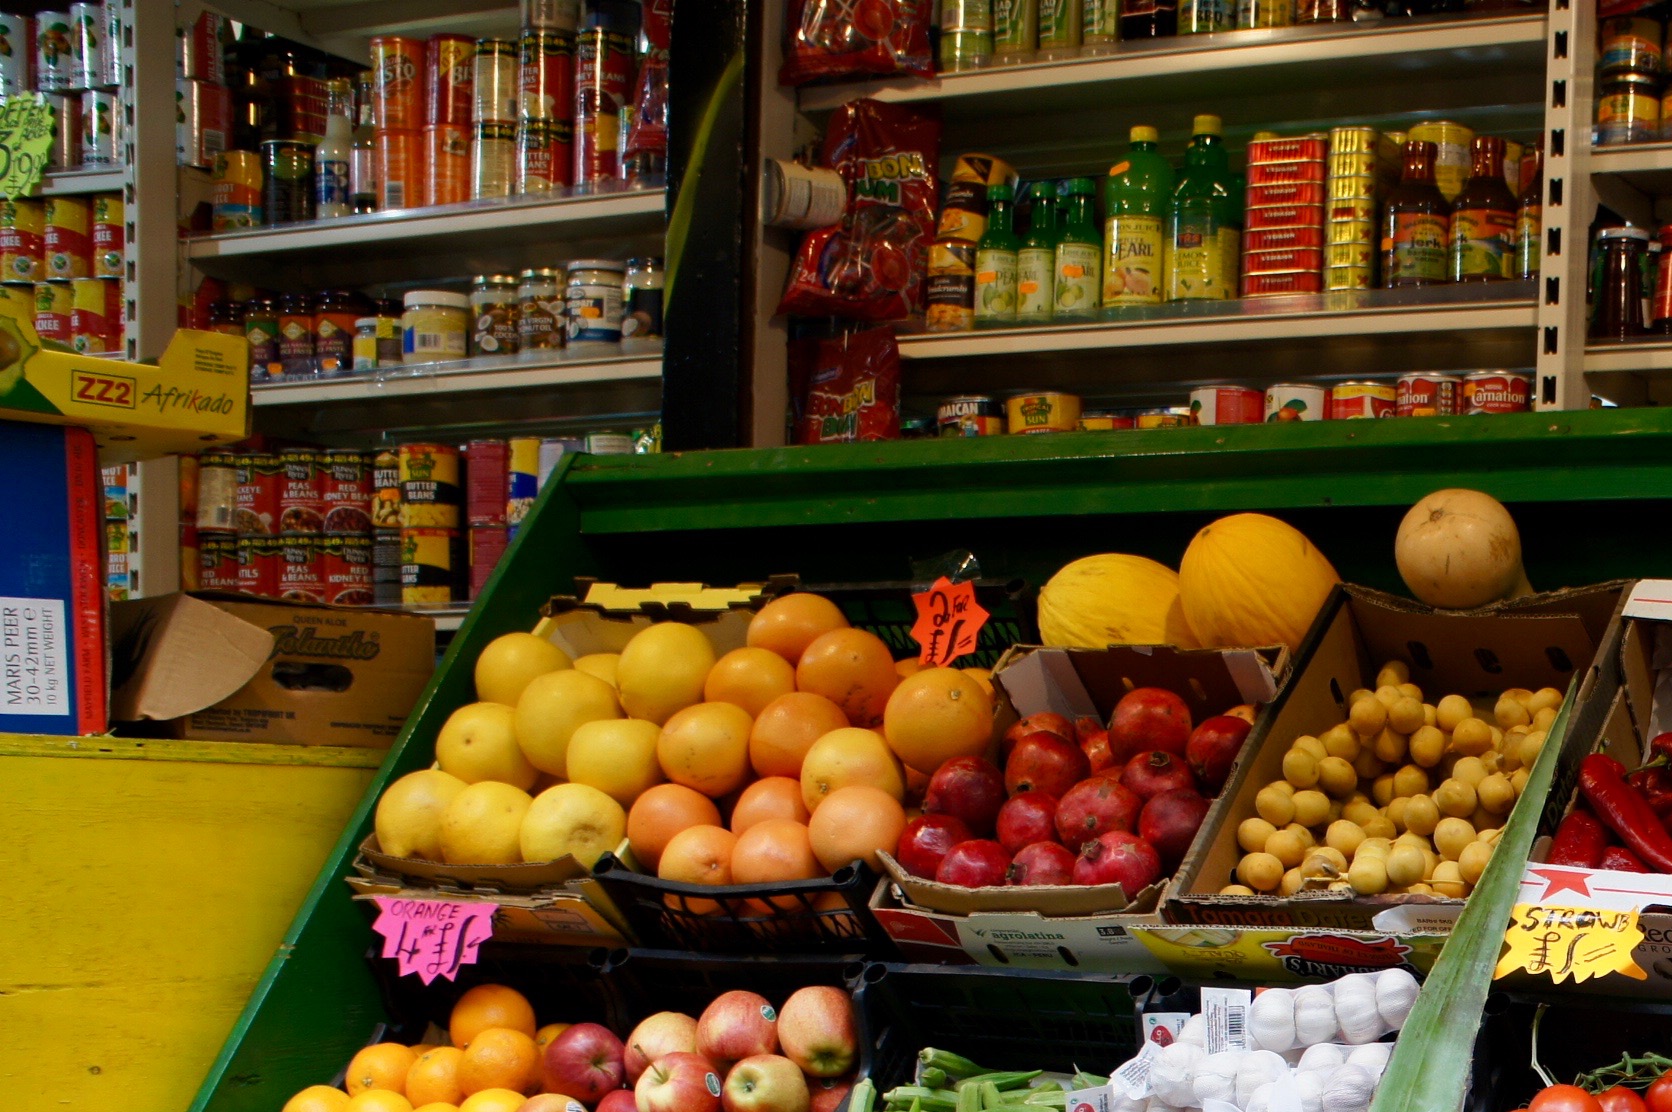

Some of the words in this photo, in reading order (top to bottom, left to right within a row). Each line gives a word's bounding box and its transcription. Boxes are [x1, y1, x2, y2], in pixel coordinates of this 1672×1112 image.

[857, 181, 898, 201] UM
[77, 376, 131, 405] ZZ2
[1471, 388, 1526, 407] Carnation
[141, 383, 234, 415] Afrikado
[1026, 414, 1046, 425] SUN
[288, 482, 309, 490] PEAS
[338, 483, 357, 492] RED
[405, 481, 437, 491] BUTTER
[289, 490, 319, 498] BEANS
[408, 490, 435, 500] BEANS
[287, 565, 309, 573] PEAS
[350, 566, 369, 575] RED
[287, 573, 318, 582] BEANS
[329, 574, 362, 583] KIDNEY
[929, 591, 950, 628] 2
[3, 606, 19, 648] PEER
[43, 608, 55, 650] WEIGHT
[293, 616, 323, 625] QUEEN
[325, 617, 348, 627] ALOE
[25, 622, 41, 705] 30-42mm
[45, 652, 56, 674] NET
[6, 652, 23, 706] MARIS
[47, 676, 60, 691] kg
[47, 693, 57, 706] 10
[390, 900, 462, 921] ORANGE
[1183, 904, 1293, 928] Tamara
[395, 921, 420, 964] 4
[991, 931, 1066, 941] agrolatina
